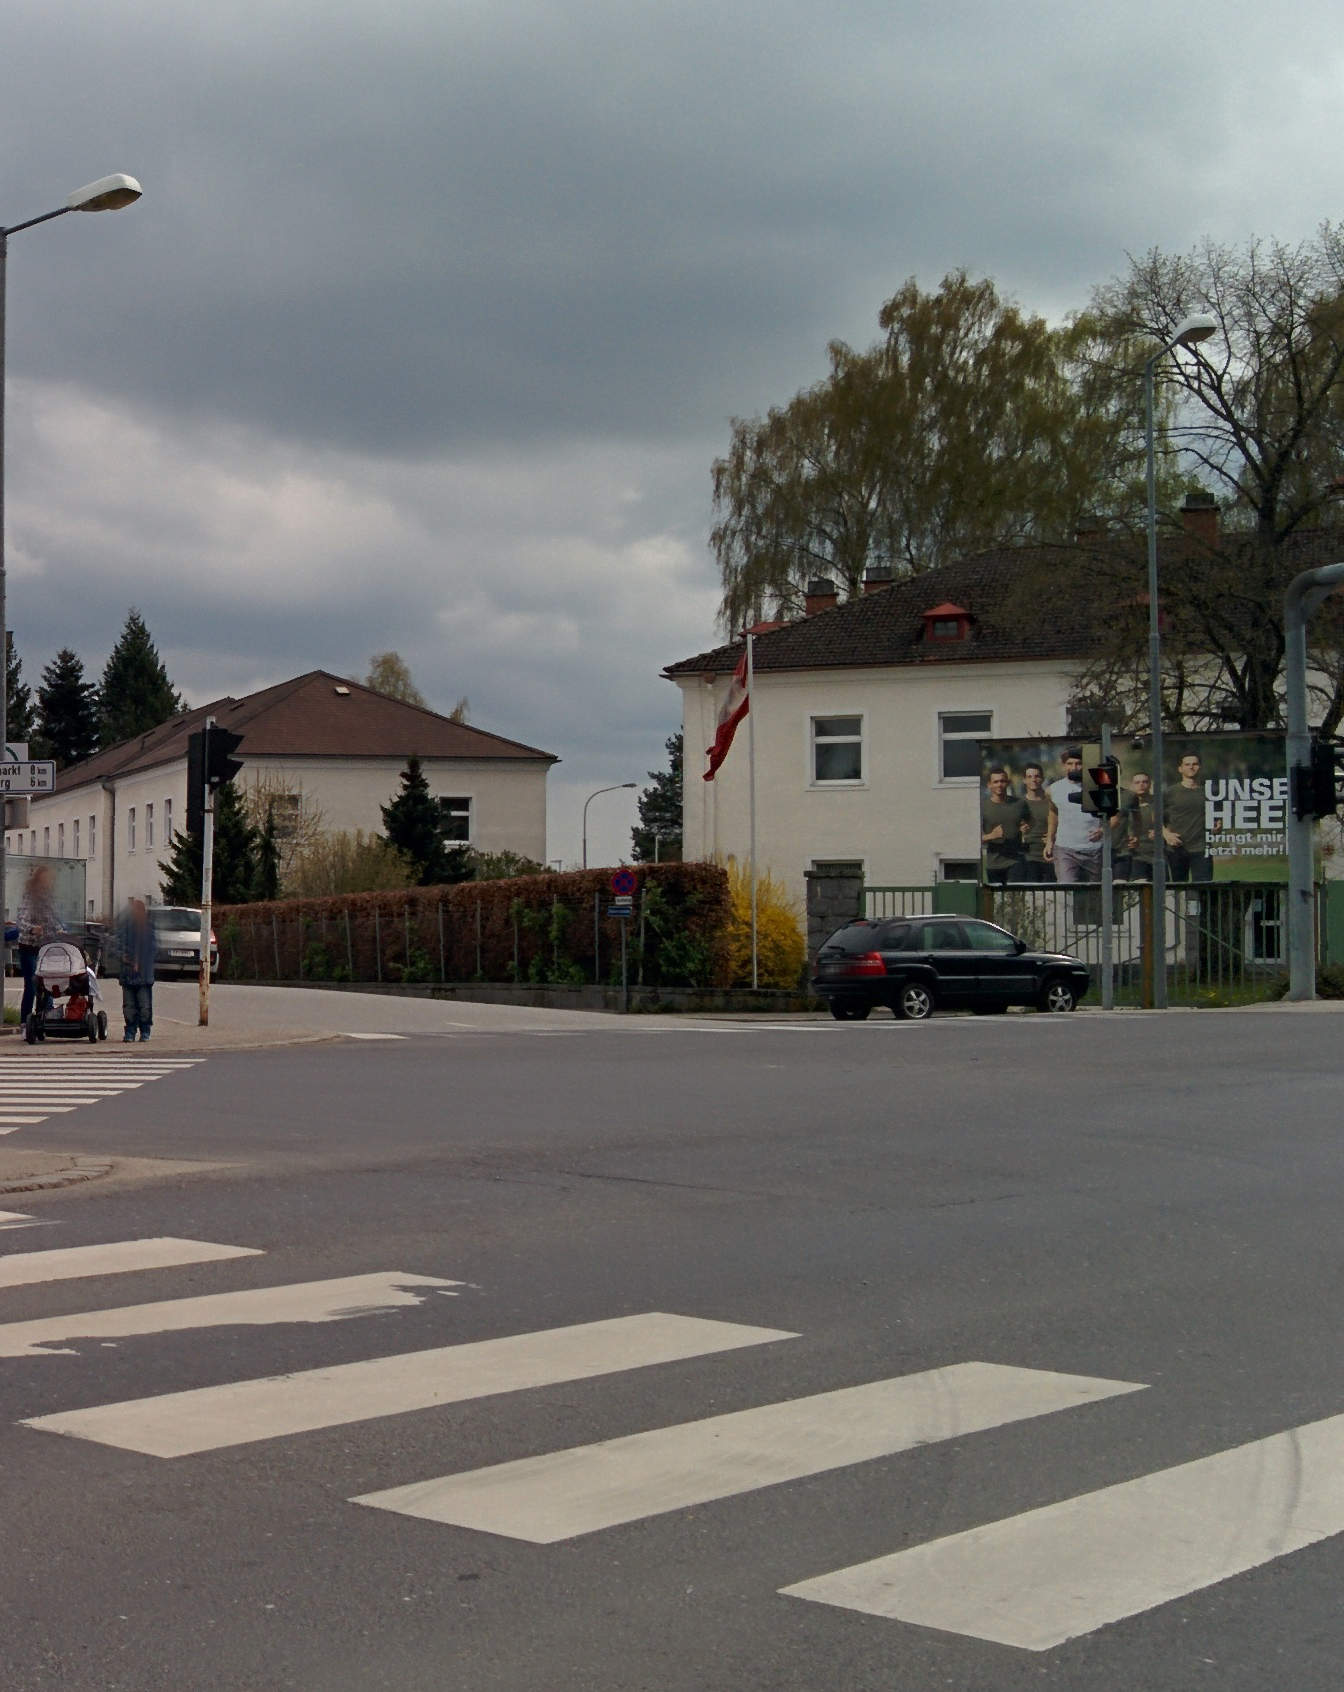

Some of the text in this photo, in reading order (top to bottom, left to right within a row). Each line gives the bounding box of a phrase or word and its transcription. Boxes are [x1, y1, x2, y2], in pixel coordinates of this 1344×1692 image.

[1204, 777, 1289, 801] UNSE
[1204, 800, 1289, 829] HEE
[1205, 831, 1284, 846] bringt mir
[1204, 845, 1283, 858] jetzt mehr!
